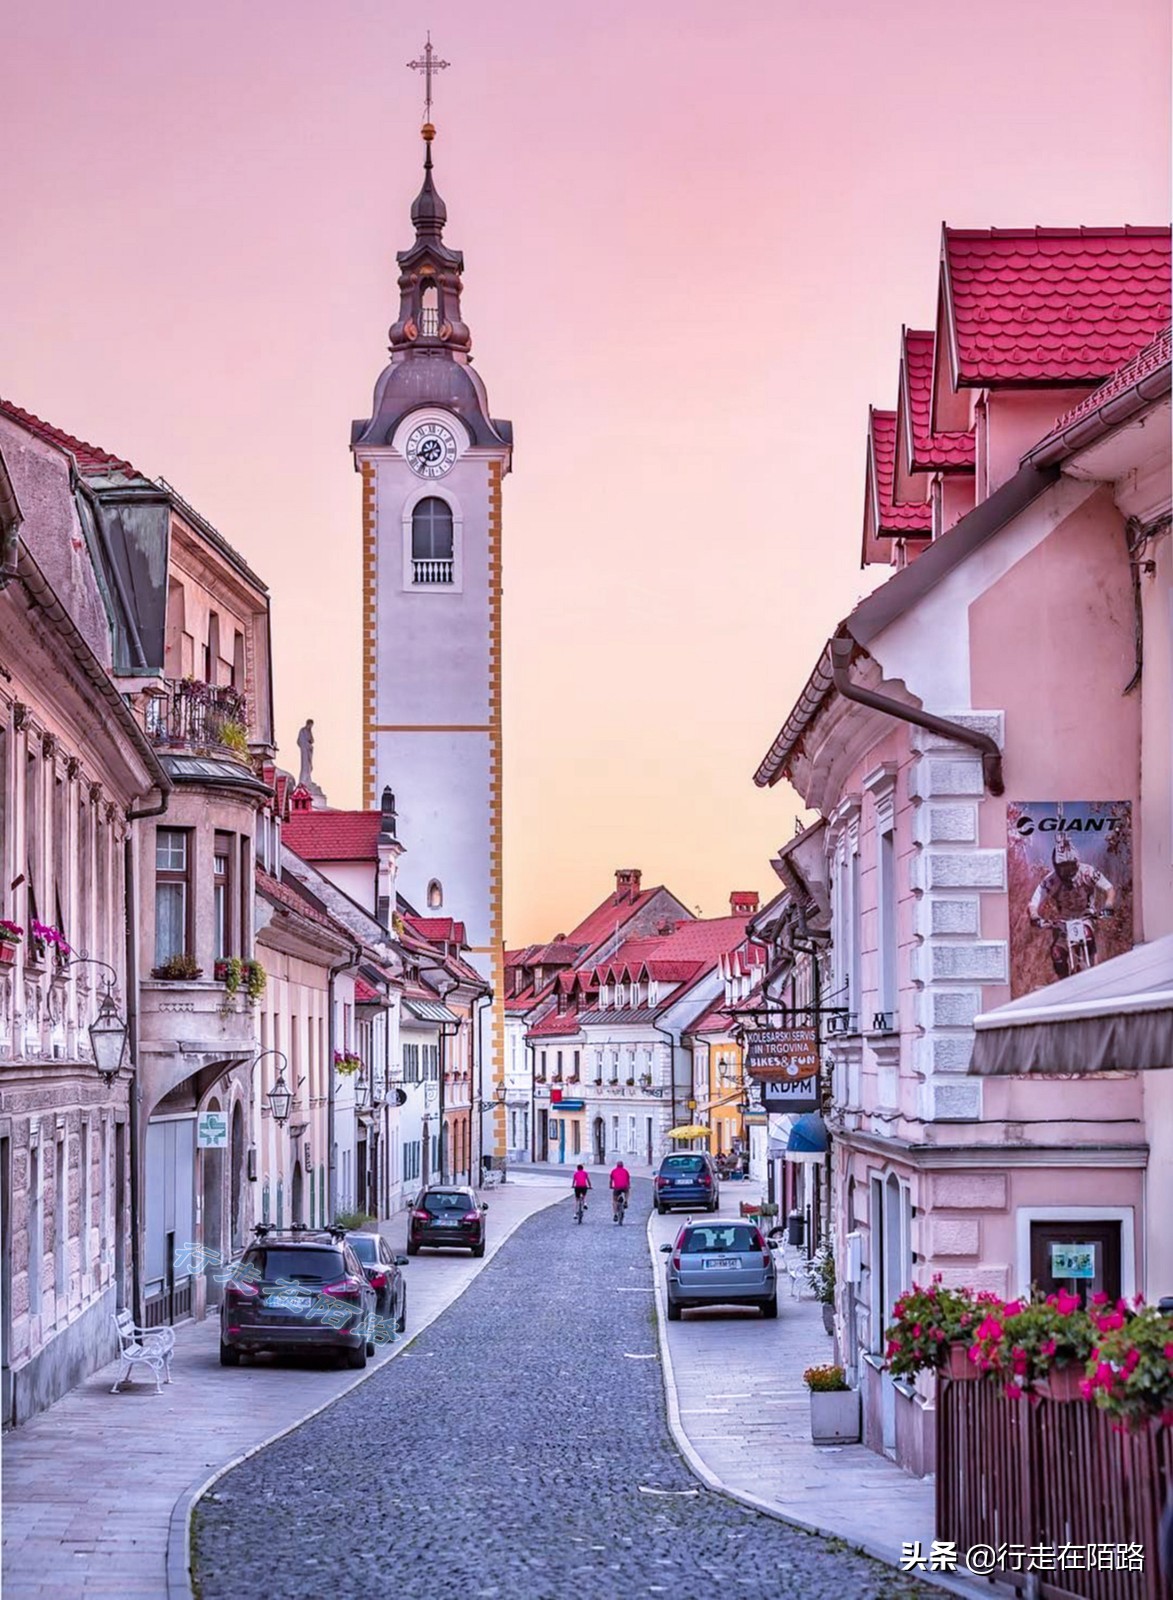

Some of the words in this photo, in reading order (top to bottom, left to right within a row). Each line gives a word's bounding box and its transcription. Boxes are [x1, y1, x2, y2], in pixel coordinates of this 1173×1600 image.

[1038, 817, 1121, 832] GIANT
[792, 1030, 816, 1042] SERVIS
[754, 1045, 763, 1054] IN
[766, 1043, 809, 1054] TRGOVINA
[770, 1078, 812, 1094] KDPM
